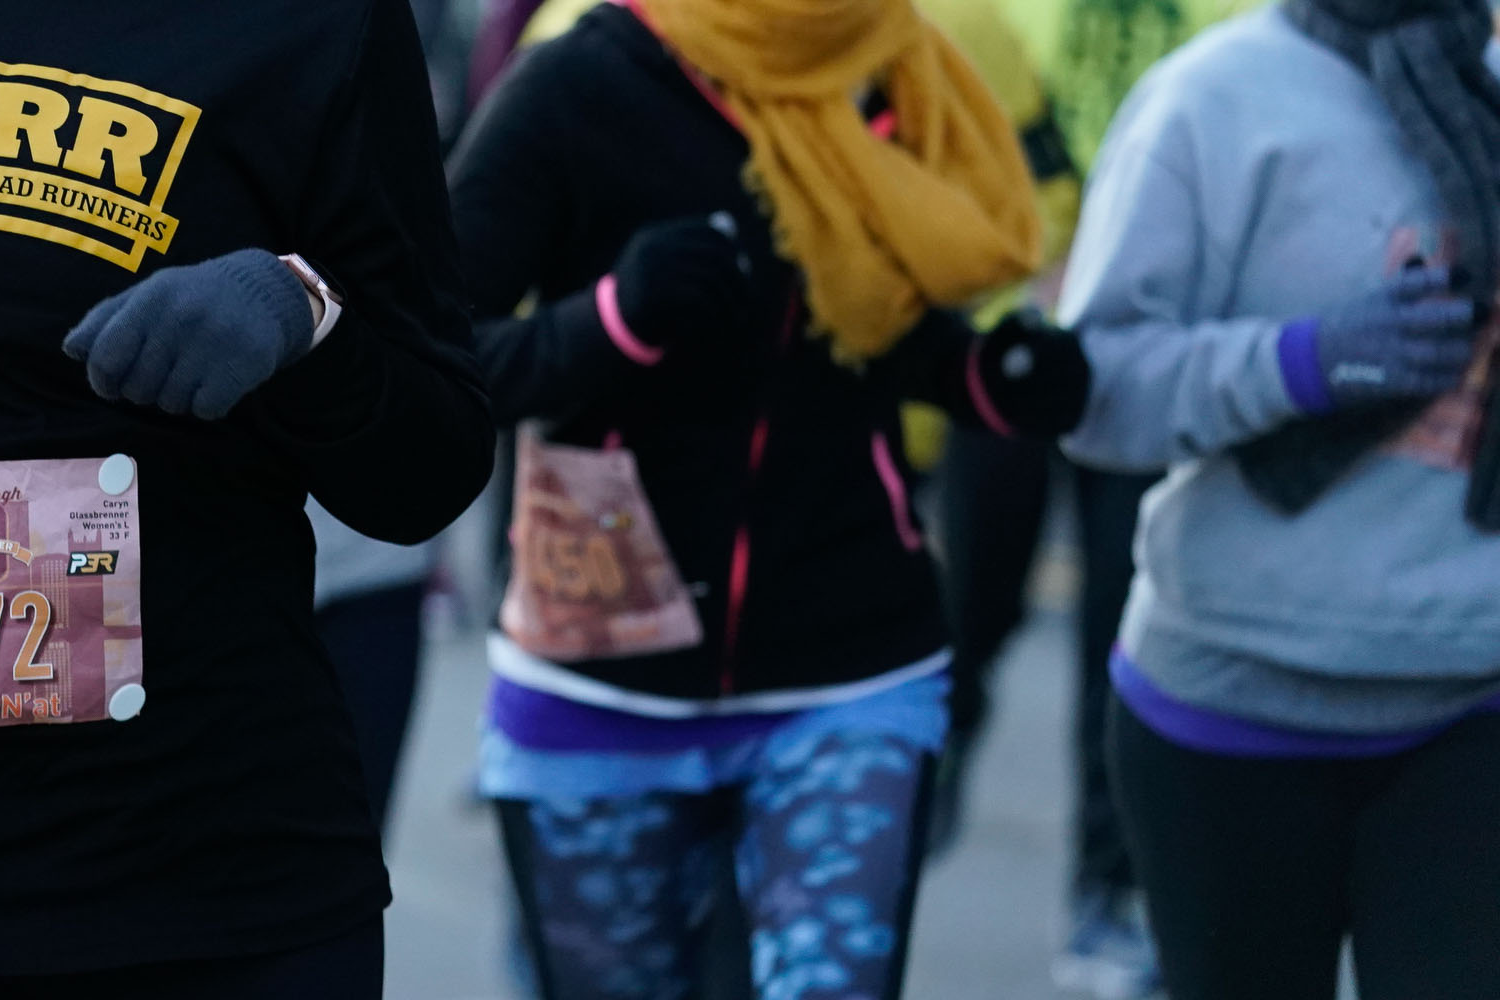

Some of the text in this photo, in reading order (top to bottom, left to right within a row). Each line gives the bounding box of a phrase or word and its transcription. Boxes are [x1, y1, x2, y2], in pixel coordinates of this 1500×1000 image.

[40, 182, 168, 242] RUNNERS
[103, 500, 129, 509] Caryn
[82, 521, 122, 530] Women's
